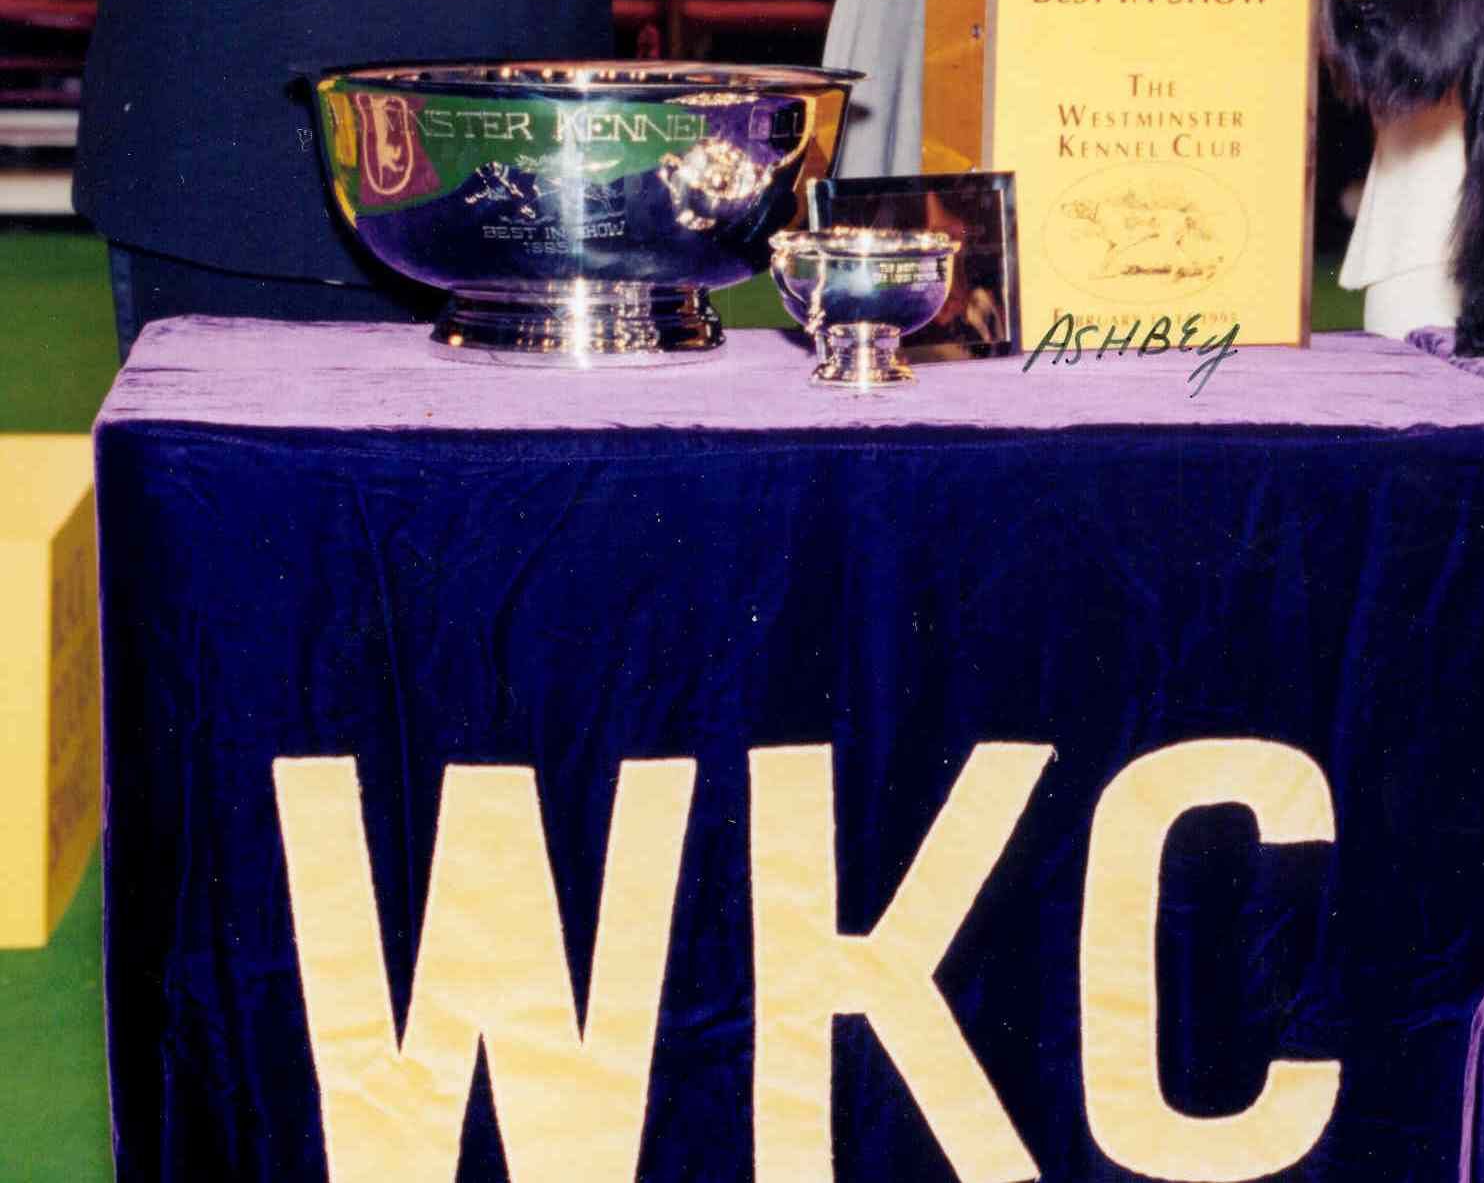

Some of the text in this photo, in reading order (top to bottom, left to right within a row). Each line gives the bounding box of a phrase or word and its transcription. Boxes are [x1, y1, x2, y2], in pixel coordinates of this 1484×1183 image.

[1128, 73, 1177, 98] THE
[1057, 103, 1244, 129] WESTMINSTER
[1058, 133, 1242, 159] KENNEL CLUB
[272, 737, 1341, 1183] WKC
